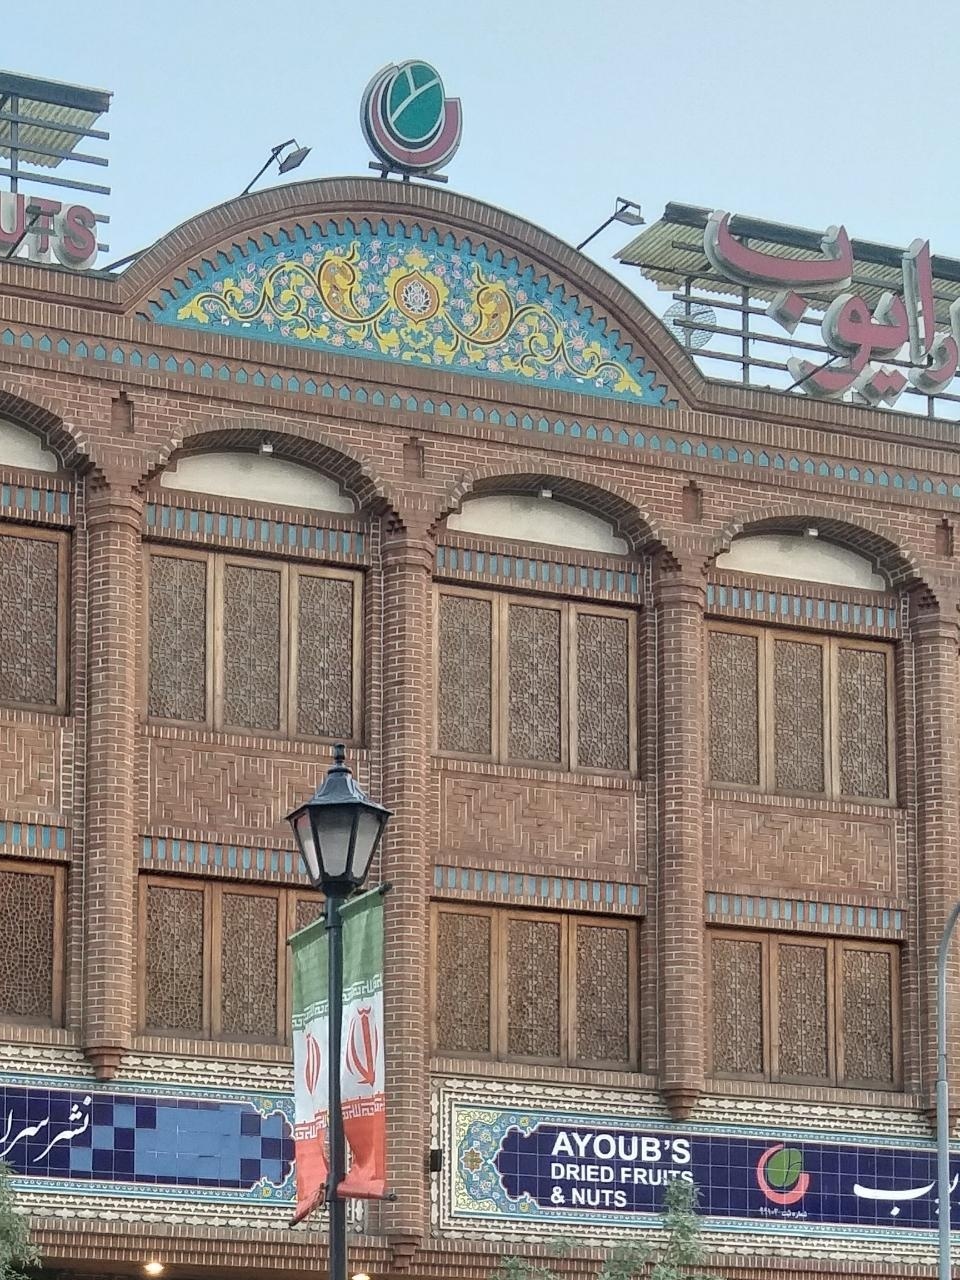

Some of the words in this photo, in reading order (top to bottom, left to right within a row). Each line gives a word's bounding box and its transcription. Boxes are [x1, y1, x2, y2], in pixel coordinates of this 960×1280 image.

[706, 210, 934, 404] ایوب
[33, 1095, 92, 1162] نشر
[551, 1131, 691, 1164] AYOUB'S
[551, 1162, 614, 1183] DRIED
[620, 1167, 694, 1186] FRUITS
[550, 1186, 566, 1204] &
[571, 1187, 627, 1208] NUTS
